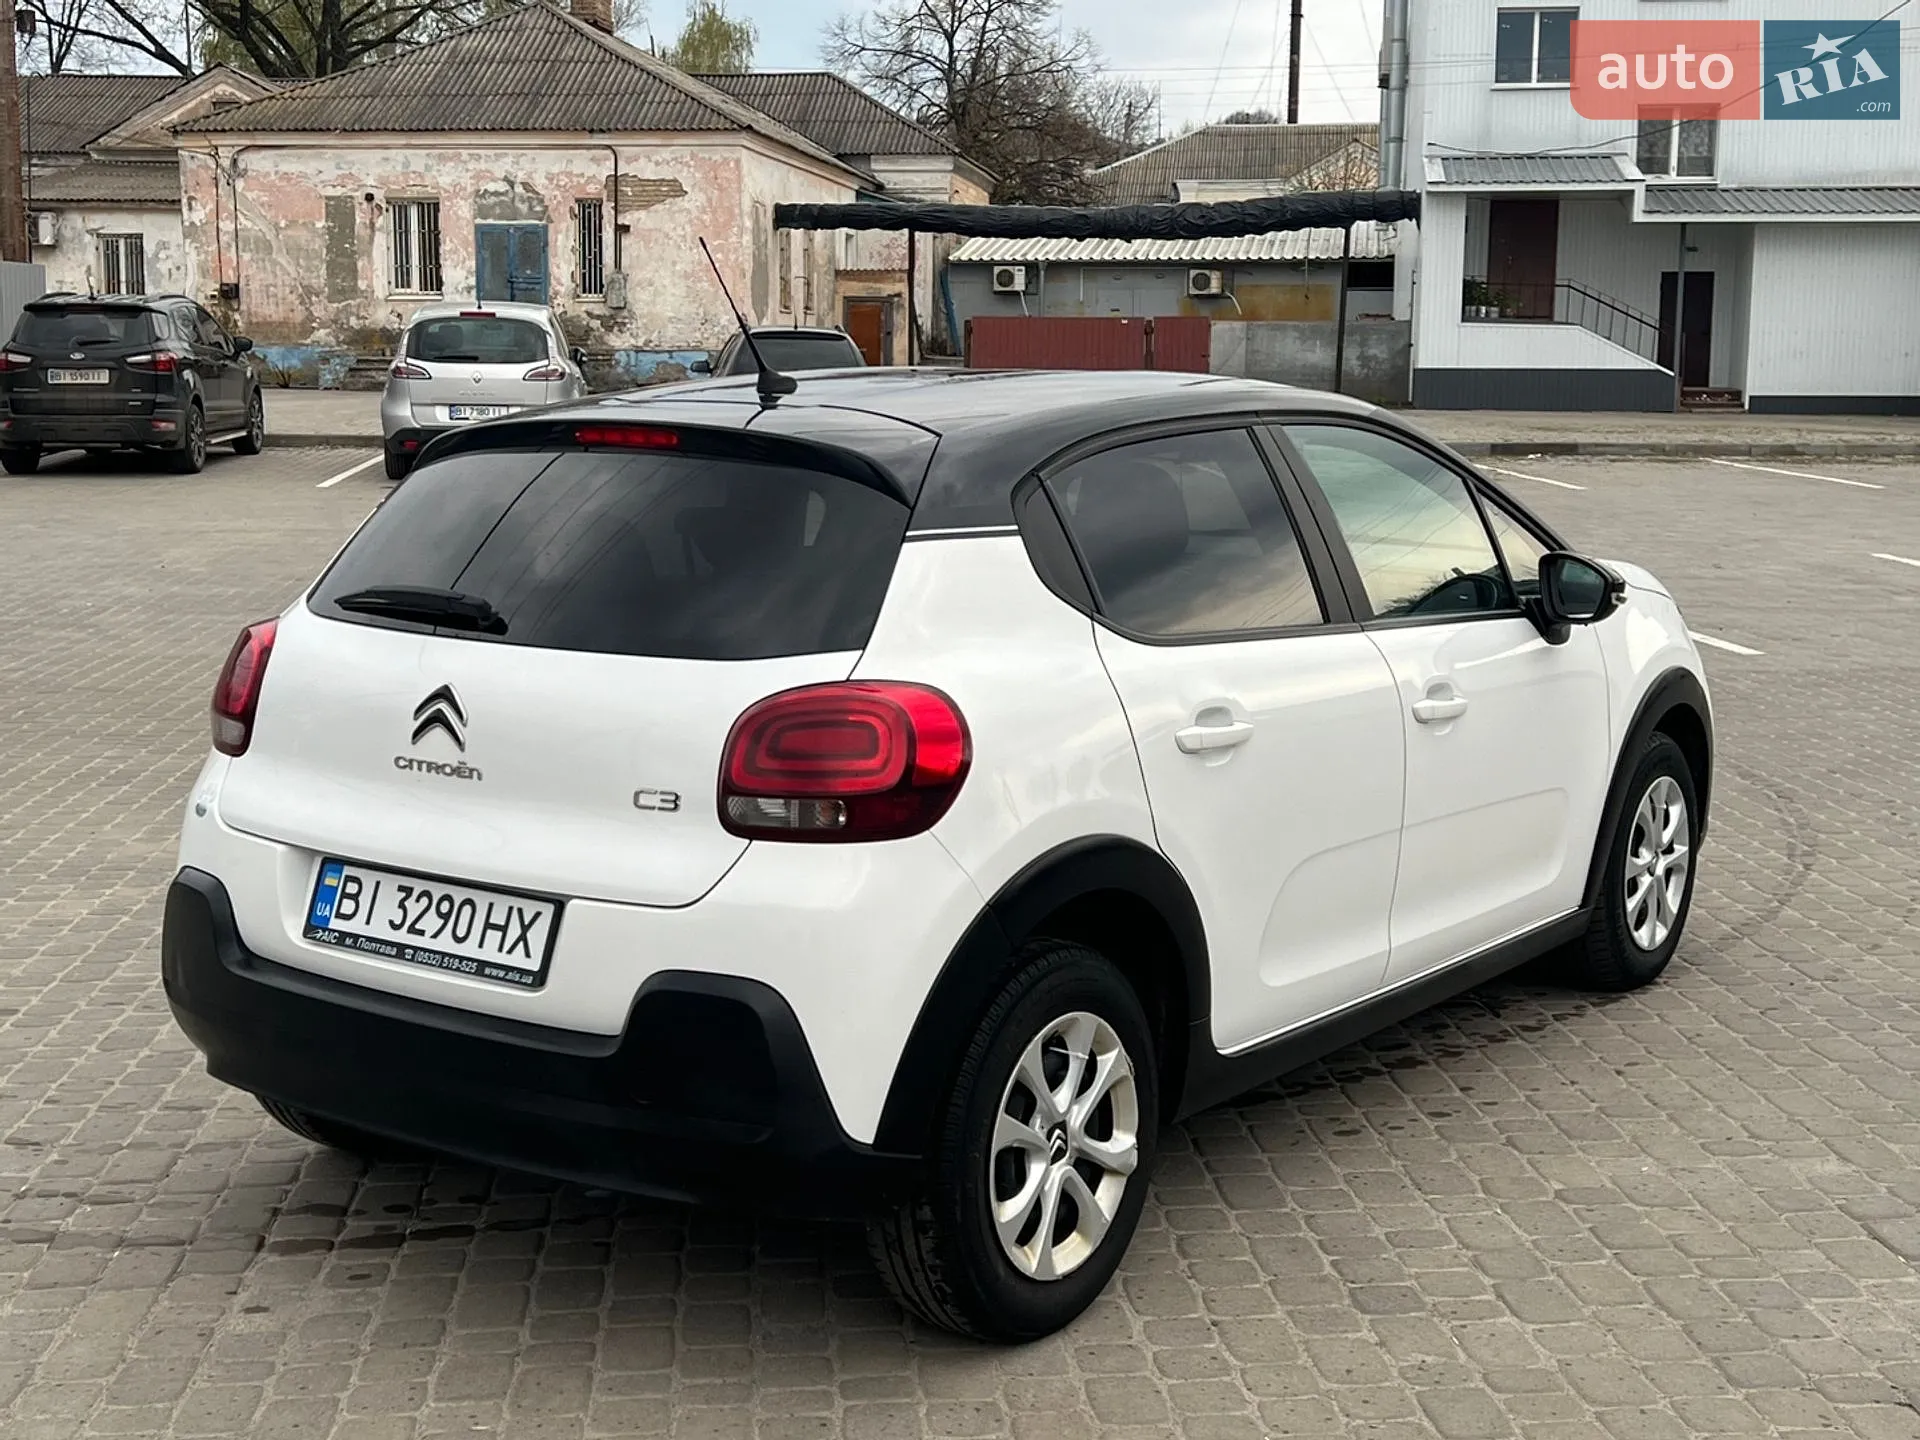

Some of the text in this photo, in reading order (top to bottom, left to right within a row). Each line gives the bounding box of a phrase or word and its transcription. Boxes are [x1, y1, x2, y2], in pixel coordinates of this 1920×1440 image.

[393, 755, 482, 781] CITROËN
[633, 789, 681, 812] C3
[316, 903, 331, 919] UA
[334, 875, 542, 959] BI 3290 HX
[357, 937, 397, 956] Полтава
[414, 950, 442, 967] (0532)
[442, 957, 477, 973] 519-525
